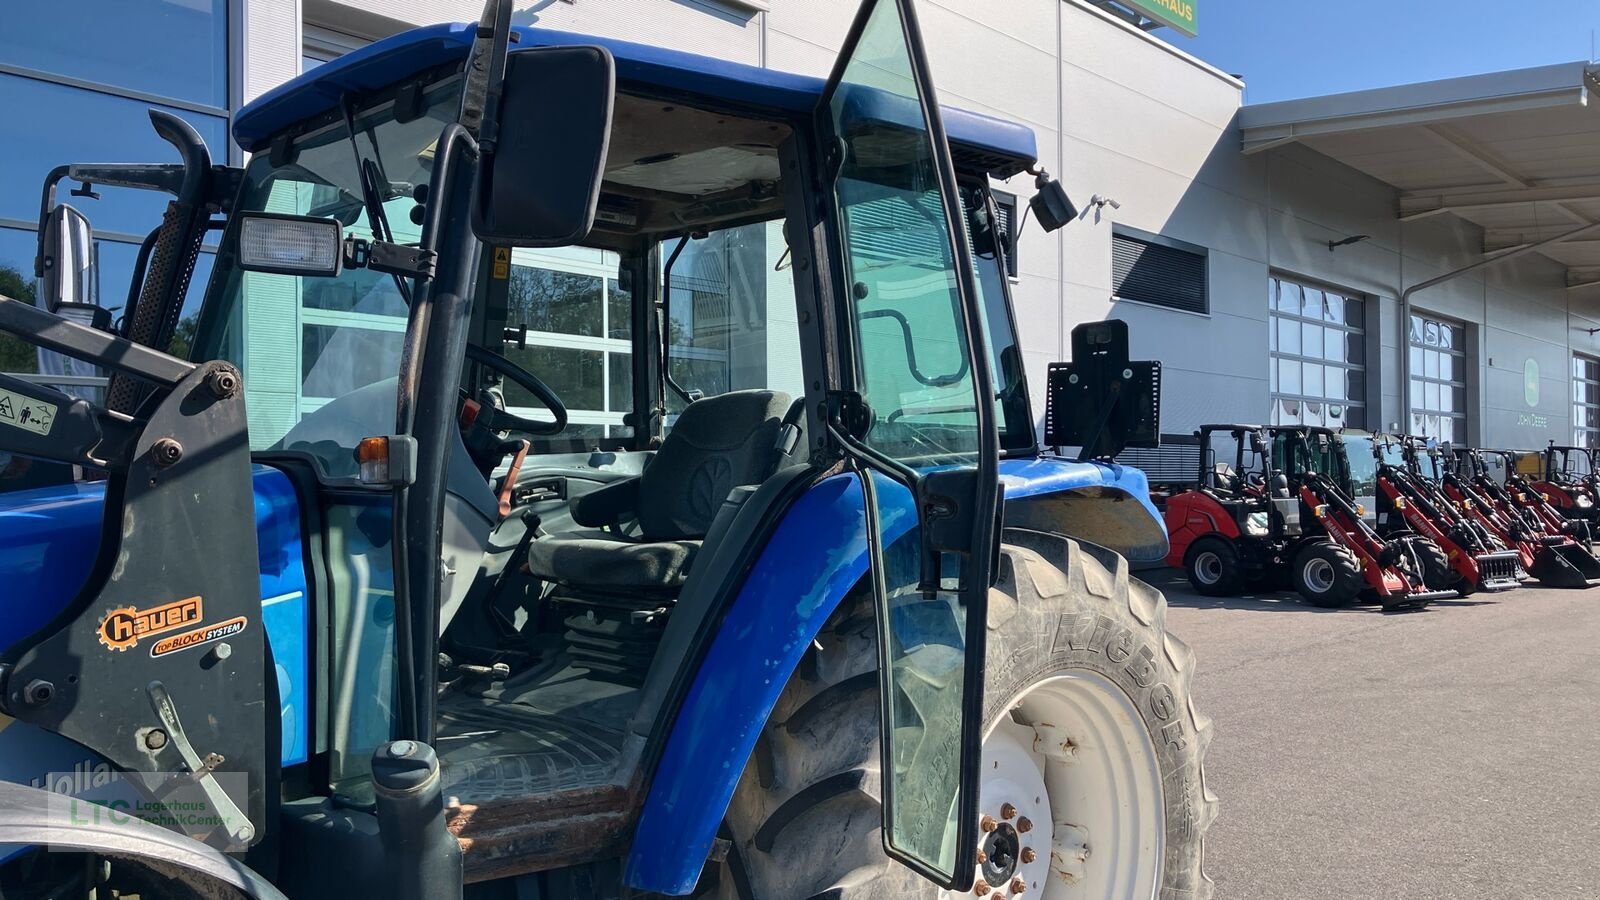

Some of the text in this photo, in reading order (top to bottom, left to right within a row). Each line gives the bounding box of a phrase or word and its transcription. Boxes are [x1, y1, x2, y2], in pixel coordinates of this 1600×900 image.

[1152, 0, 1193, 21] HAUS
[113, 603, 196, 641] hauer
[206, 622, 241, 640] SYSTEM
